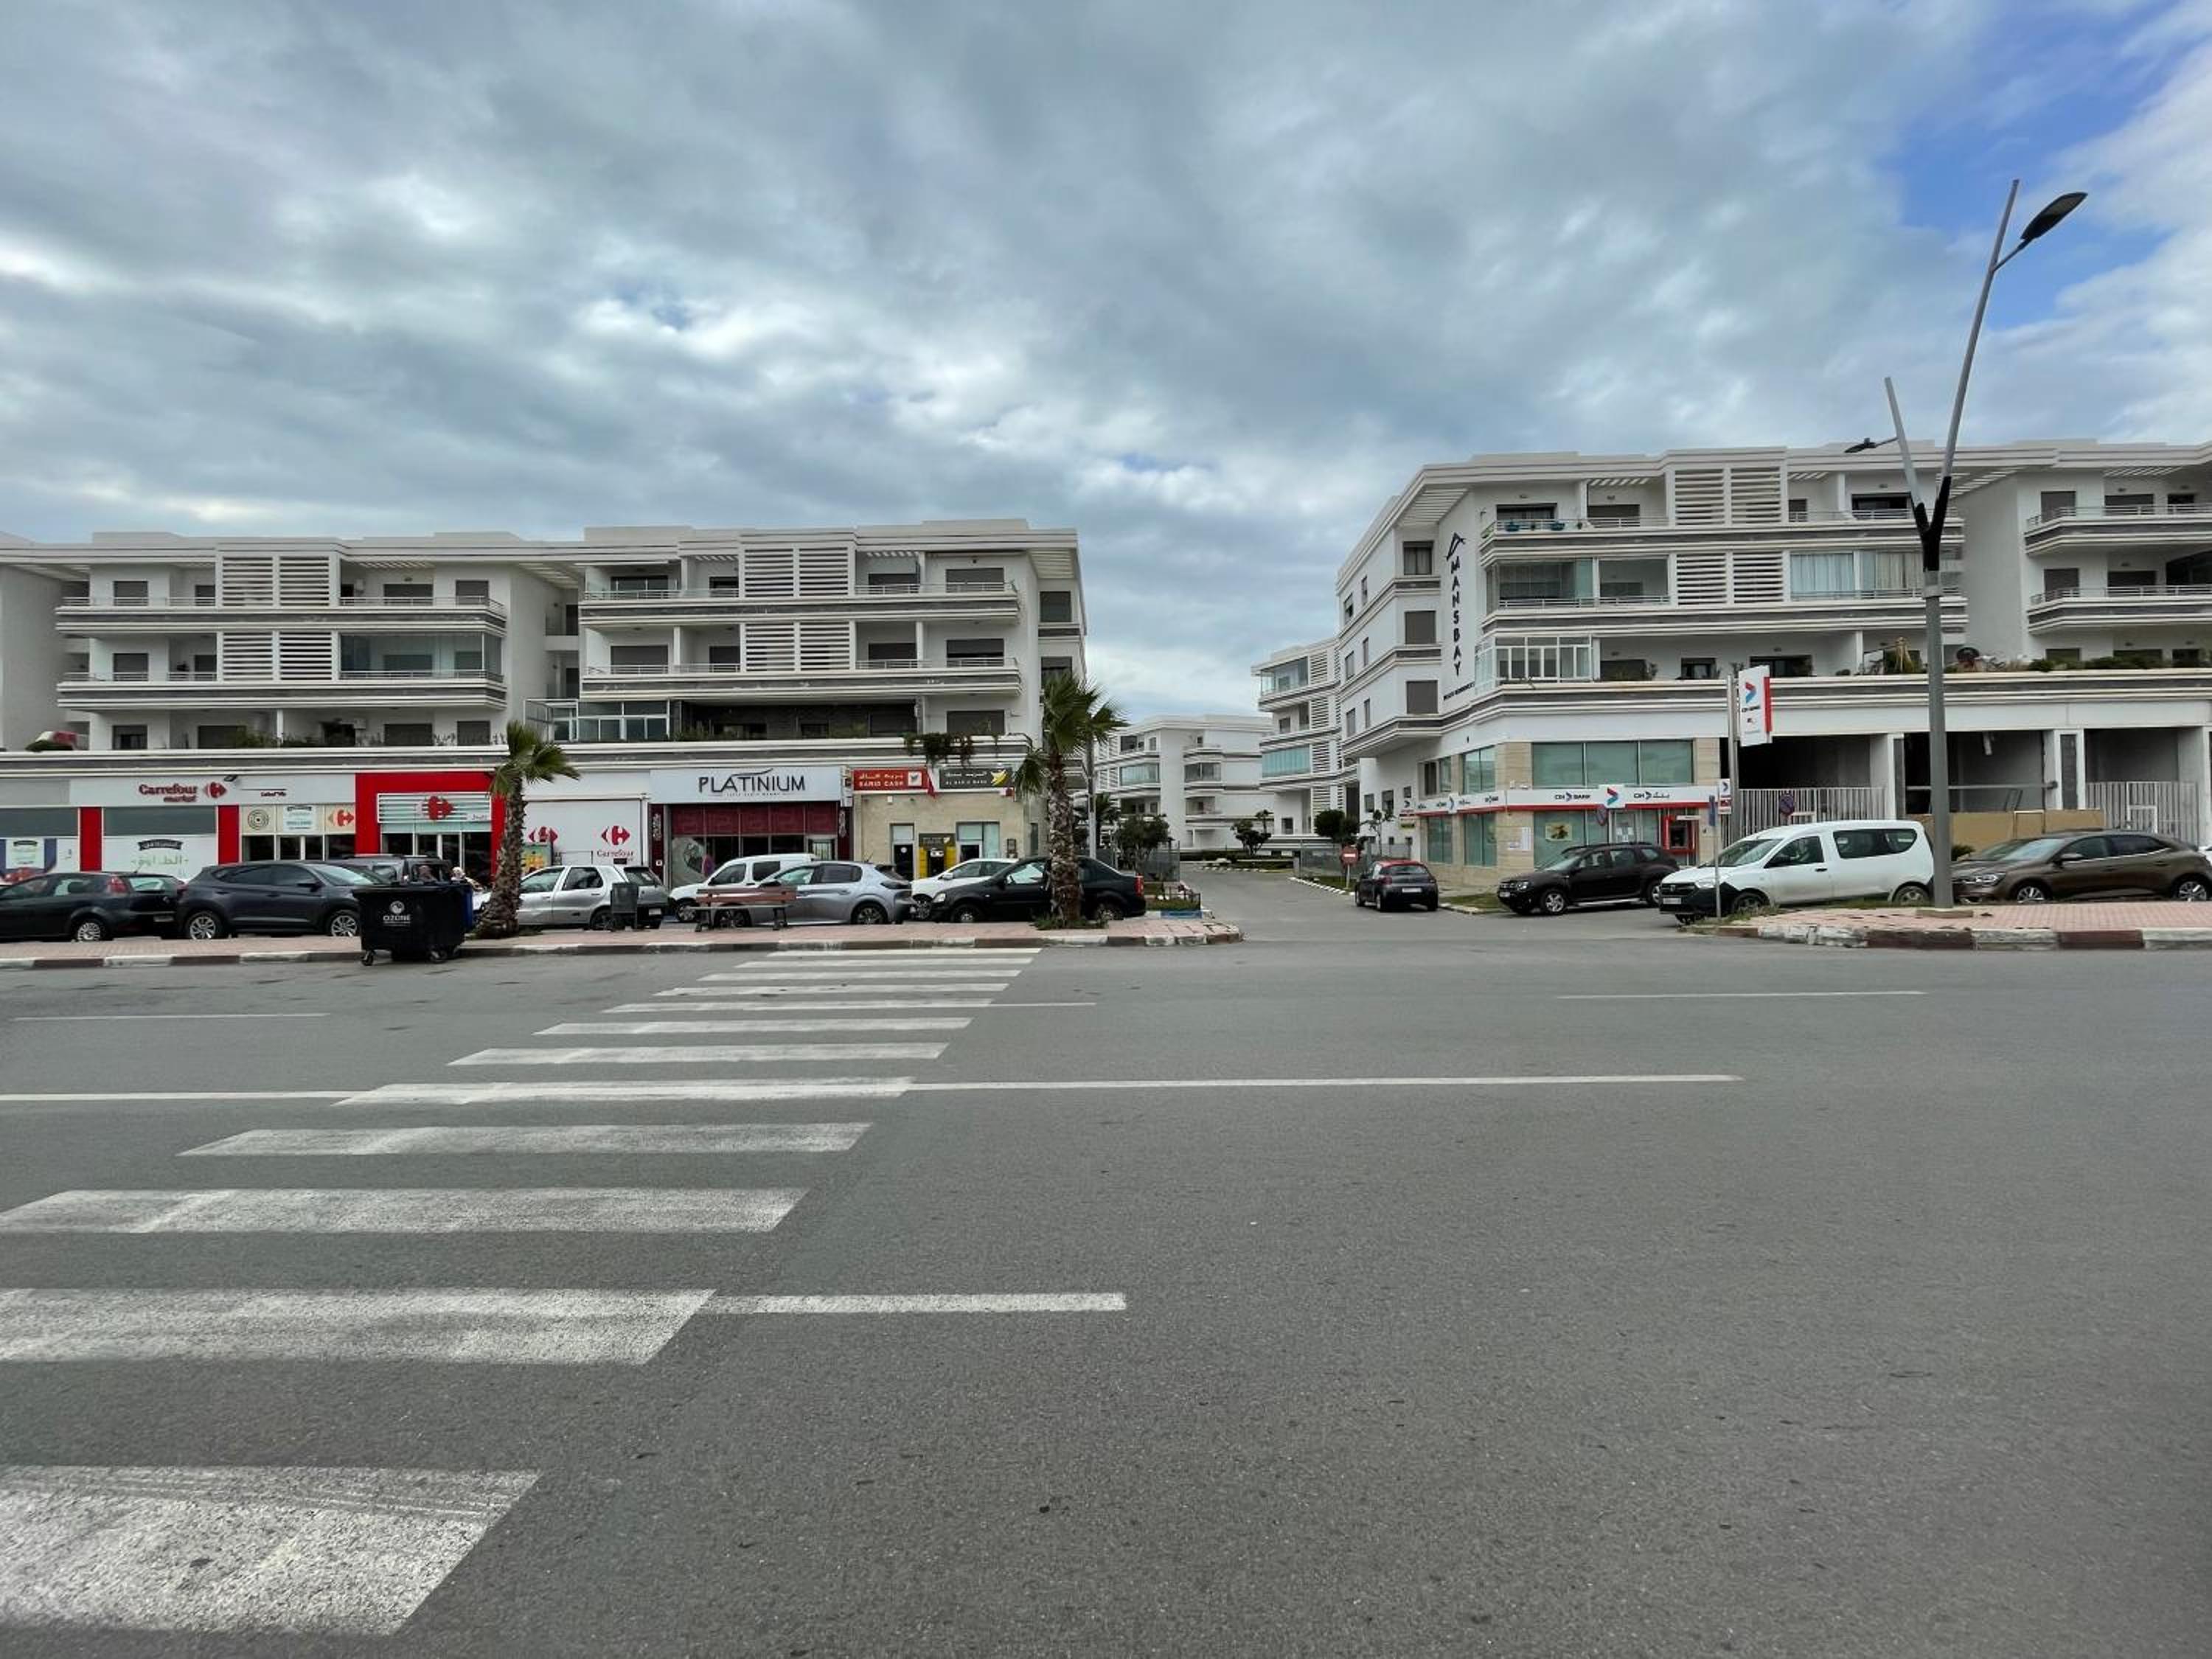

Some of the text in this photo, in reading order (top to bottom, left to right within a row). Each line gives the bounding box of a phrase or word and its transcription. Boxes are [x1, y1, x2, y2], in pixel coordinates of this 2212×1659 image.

[1450, 554, 1461, 677] MANSBAY
[139, 784, 198, 795] Carrefour
[698, 773, 806, 793] PLATINIUM
